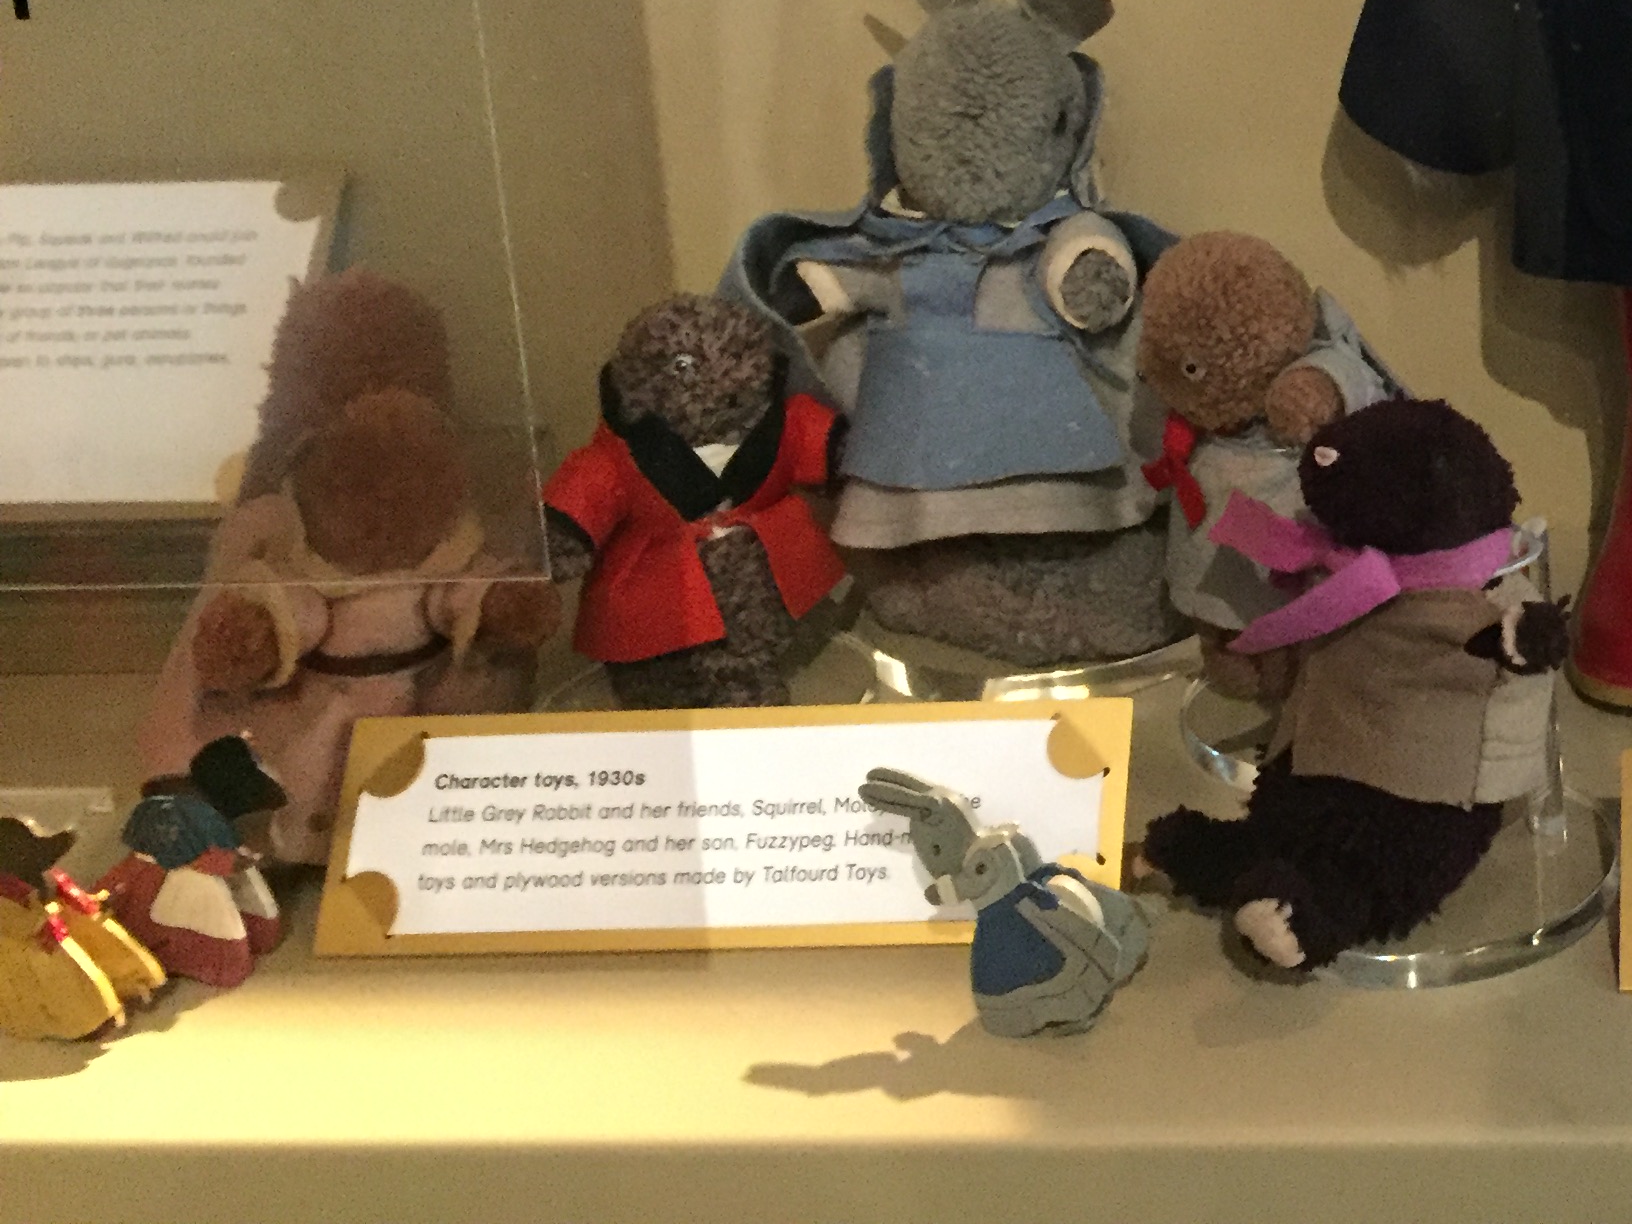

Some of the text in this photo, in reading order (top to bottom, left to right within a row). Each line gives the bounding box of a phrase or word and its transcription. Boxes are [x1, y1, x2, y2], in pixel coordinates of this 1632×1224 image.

[434, 770, 646, 791] Character toys, 1930s
[428, 805, 475, 823] Little
[481, 805, 526, 824] Grey
[532, 803, 592, 821] Rabbit
[599, 803, 634, 820] and
[640, 802, 671, 819] her
[677, 800, 745, 819] friends,
[751, 798, 827, 820] Squirrel,
[479, 838, 513, 855] Mrs
[519, 837, 616, 858] Hedgehog
[622, 835, 658, 852] and
[665, 834, 695, 851] her
[417, 875, 455, 893] toys
[462, 874, 497, 890] and
[503, 871, 583, 891] plywood
[590, 870, 666, 887] versions
[673, 868, 726, 885] made
[733, 867, 755, 887] by
[763, 865, 839, 884] Talfourd
